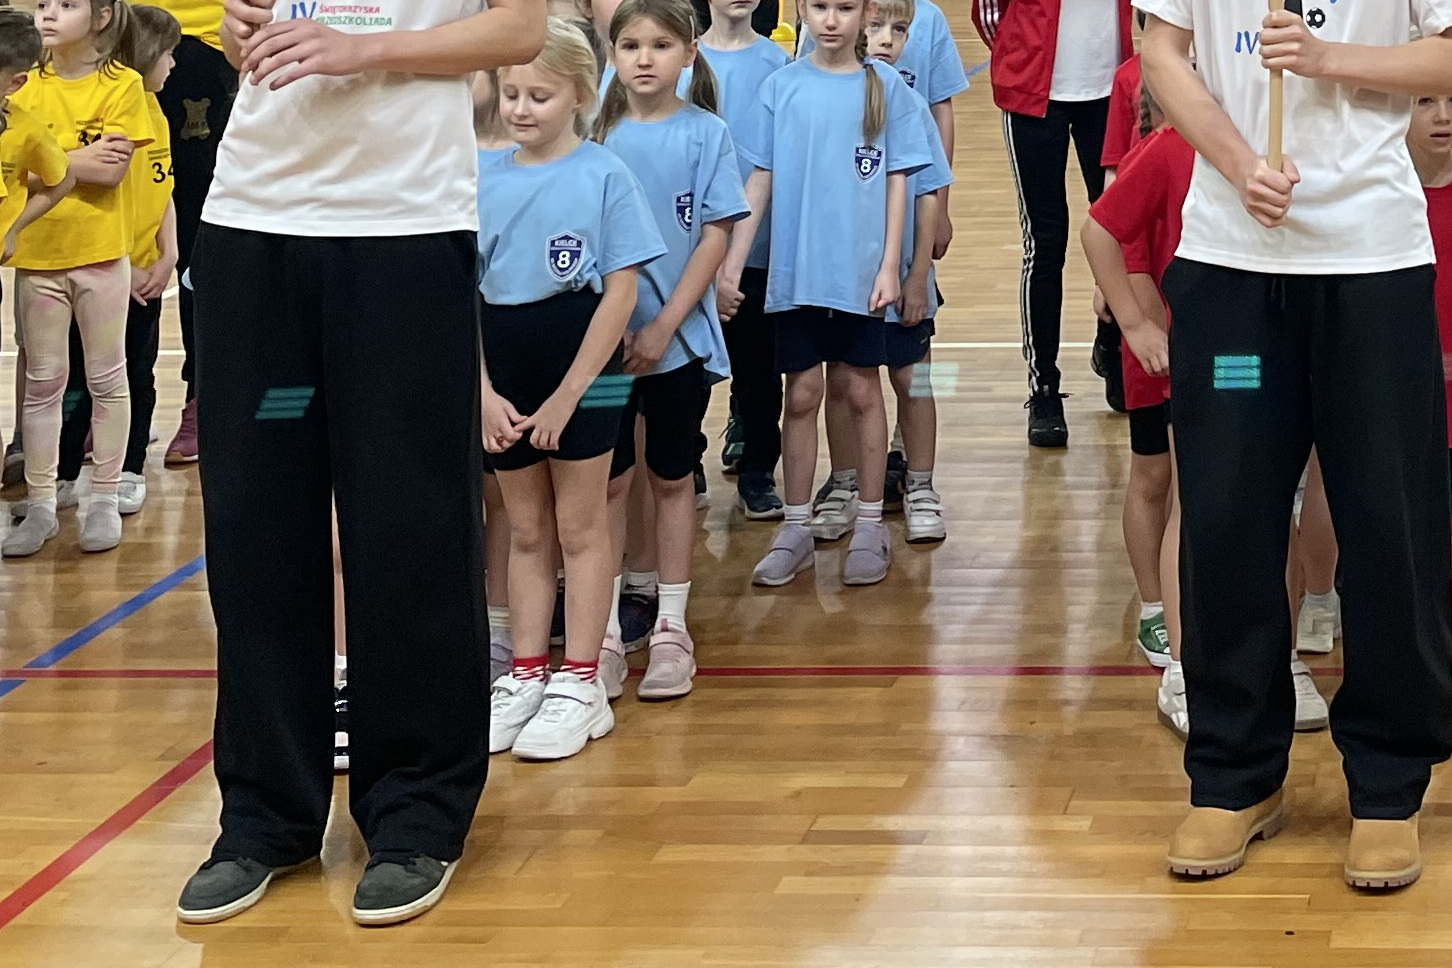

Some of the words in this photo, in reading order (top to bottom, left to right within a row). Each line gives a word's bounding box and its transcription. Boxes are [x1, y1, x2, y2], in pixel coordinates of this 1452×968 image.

[290, 1, 318, 21] IV
[1234, 30, 1260, 55] IV
[860, 158, 872, 174] 8
[556, 250, 571, 269] 8
